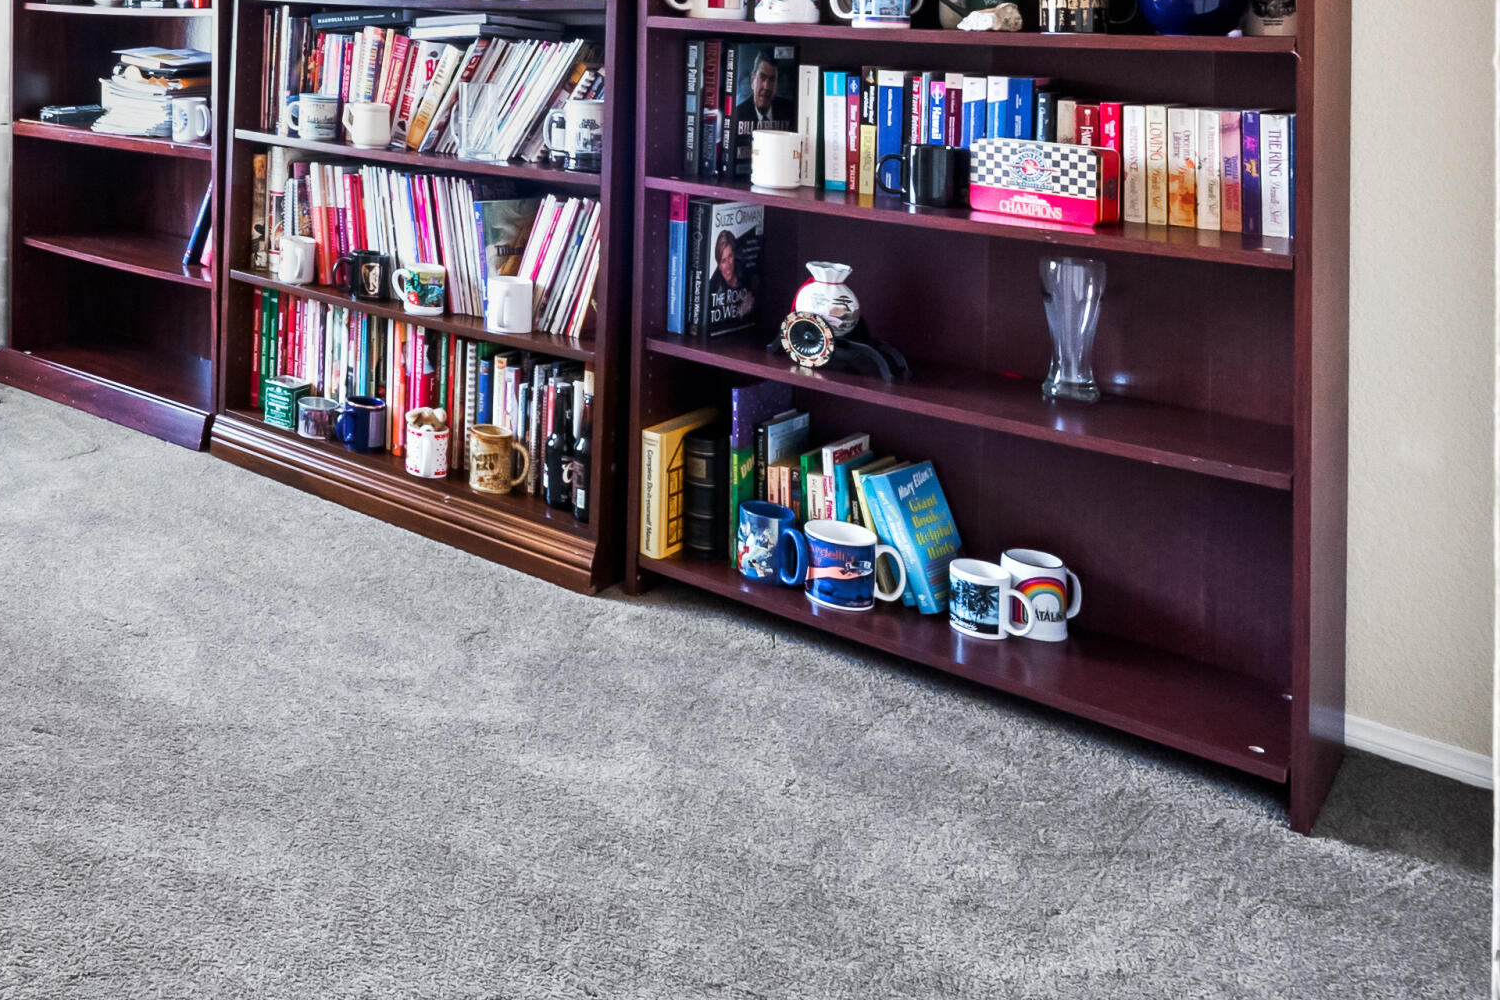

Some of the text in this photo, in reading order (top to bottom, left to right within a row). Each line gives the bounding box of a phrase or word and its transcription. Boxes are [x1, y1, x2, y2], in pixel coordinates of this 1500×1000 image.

[317, 16, 343, 24] MAGNOLIA
[687, 44, 698, 68] Killing
[687, 68, 697, 92] Patton
[912, 93, 920, 113] Travel
[931, 106, 942, 140] Hawaii
[1149, 121, 1163, 161] LOVING
[1268, 129, 1282, 152] THE
[1268, 152, 1283, 177] RING
[715, 211, 735, 228] SUZE
[999, 199, 1062, 220] CHAMPIONS
[695, 280, 703, 295] ROAD
[711, 287, 748, 307] THE ROAD
[693, 303, 702, 325] WEALTH
[710, 309, 722, 323] TO
[415, 338, 424, 379] ROMNEY
[898, 466, 934, 501] Mary Ellen's
[645, 481, 653, 526] Do-it-yourself
[908, 493, 938, 513] Giant
[911, 511, 939, 529] Book
[644, 526, 652, 552] Manual
[915, 521, 955, 546] Helpful
[926, 543, 955, 561] Hints
